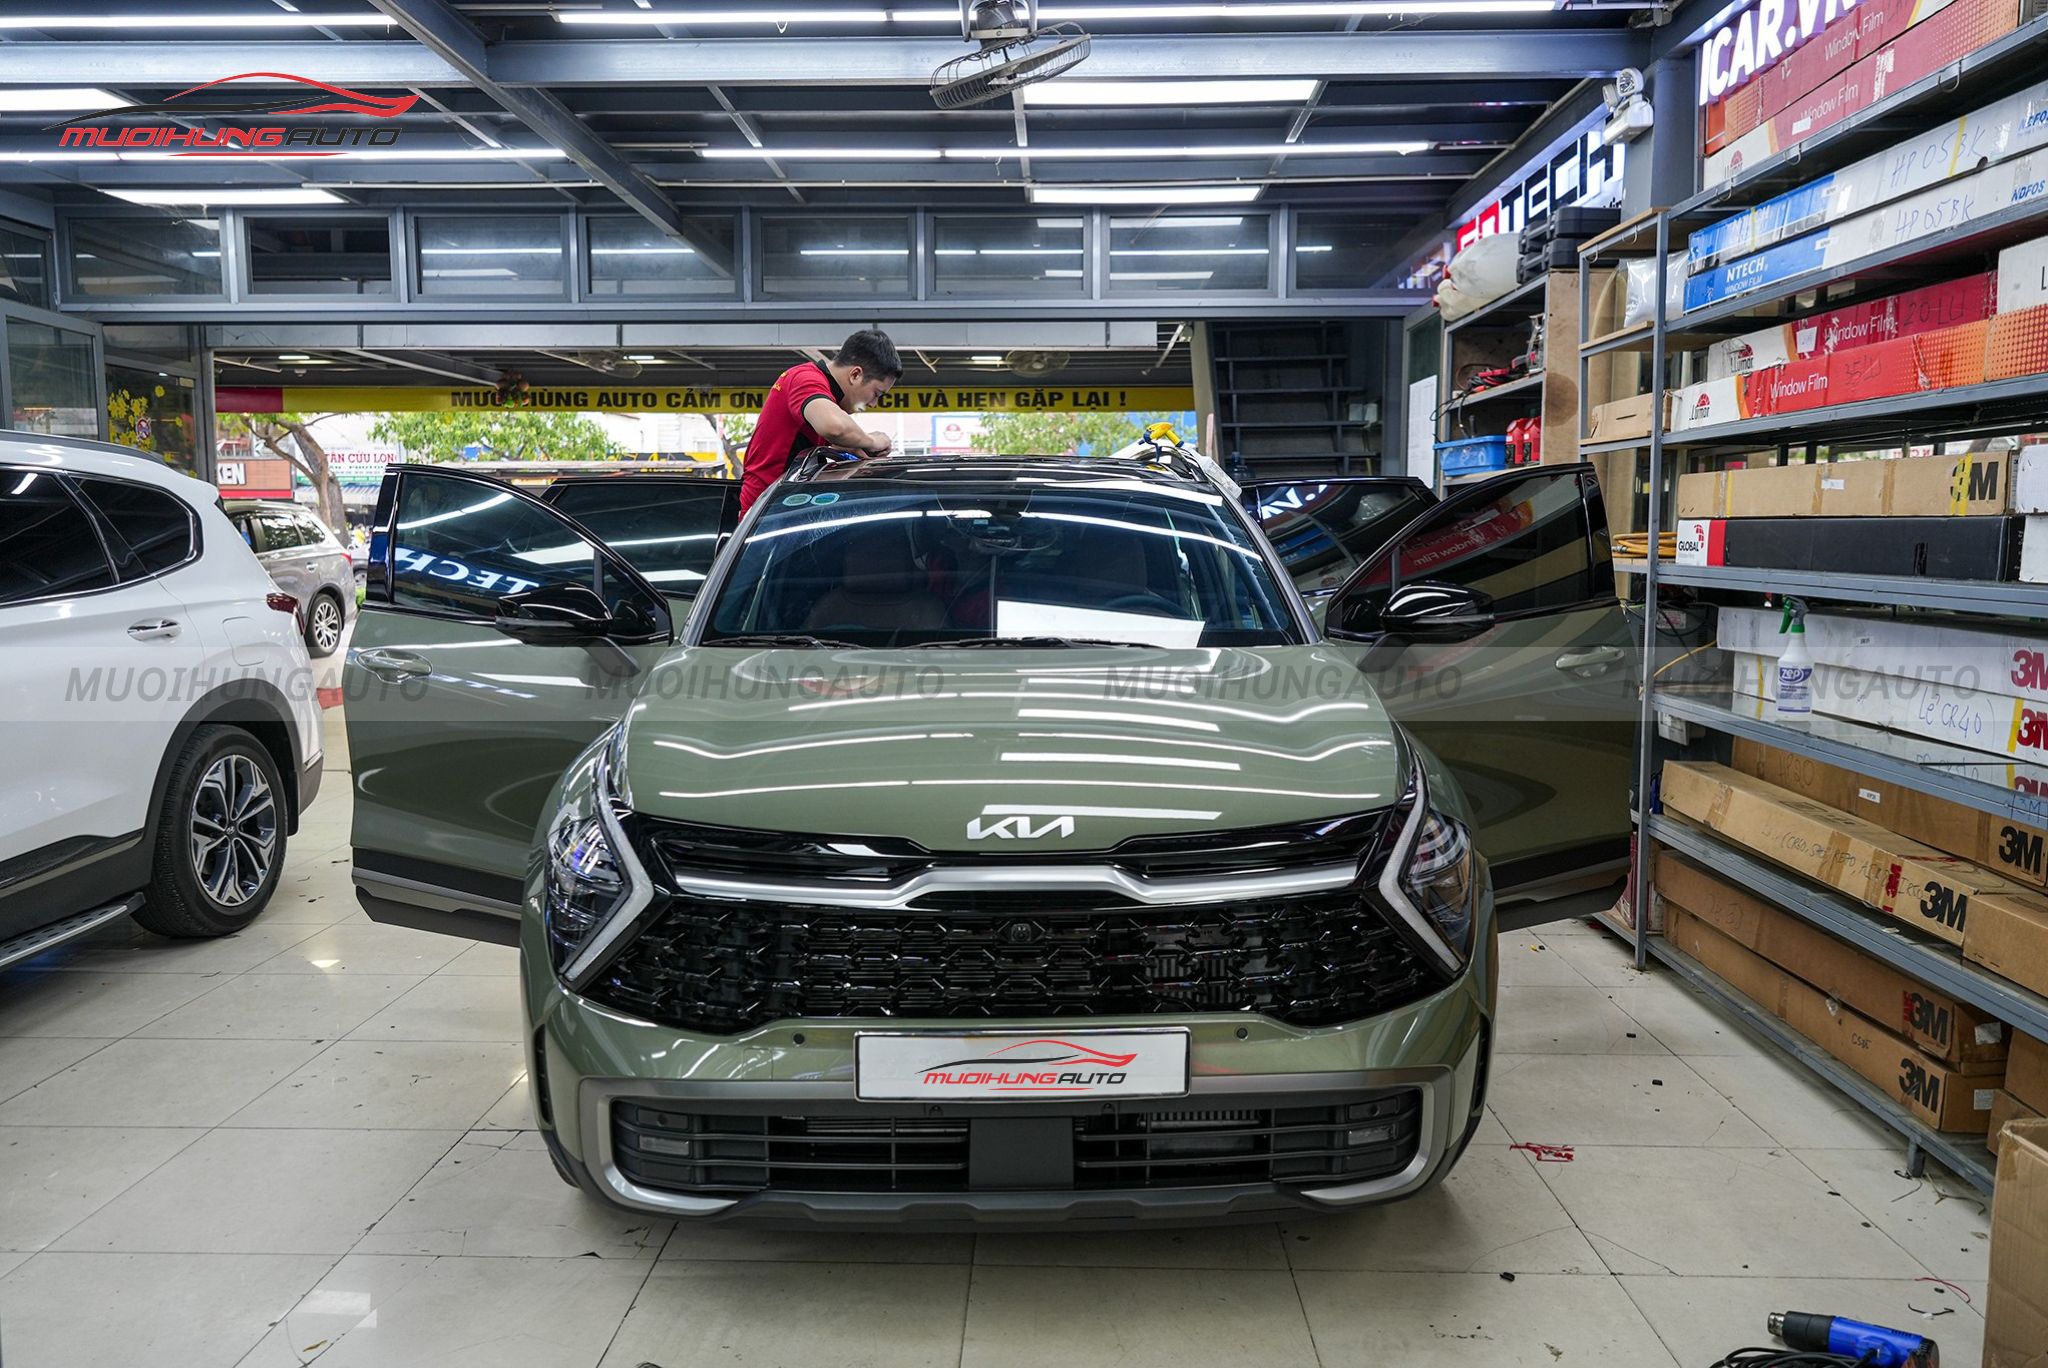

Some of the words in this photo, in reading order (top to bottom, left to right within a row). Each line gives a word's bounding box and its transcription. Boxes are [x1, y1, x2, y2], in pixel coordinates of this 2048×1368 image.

[1824, 26, 1860, 61] Window
[1861, 10, 1884, 37] Film
[1801, 94, 1837, 121] Window
[1837, 83, 1859, 105] Film
[2011, 179, 2046, 202] NDFOS
[1724, 280, 1748, 295] WINDOW
[1749, 275, 1763, 288] FILM
[1726, 256, 1765, 283] NTECH
[1824, 318, 1867, 342] Window
[1869, 314, 1895, 335] Film
[597, 392, 657, 408] AUTO
[665, 386, 721, 408] CẢM
[730, 391, 763, 408] ƠN
[918, 386, 950, 408] VÀ
[957, 391, 1006, 411] HẸN
[1014, 387, 1064, 411] GẶP
[1072, 391, 1109, 412] LẠI
[1119, 391, 1127, 408] !
[1769, 378, 1806, 398] Window
[1807, 373, 1828, 392] Film
[1950, 461, 1999, 502] 3M
[1678, 541, 1699, 552] GLOBAL
[2011, 649, 2048, 691] 3M
[2016, 708, 2048, 751] 3M
[966, 815, 1075, 840] KIA
[1998, 825, 2044, 875] 3M
[1919, 880, 1968, 933] 3M
[1910, 992, 1949, 1046] 3M
[922, 1072, 1127, 1085] MUOIHUNGAUTO
[1898, 1058, 1940, 1114] 3M
